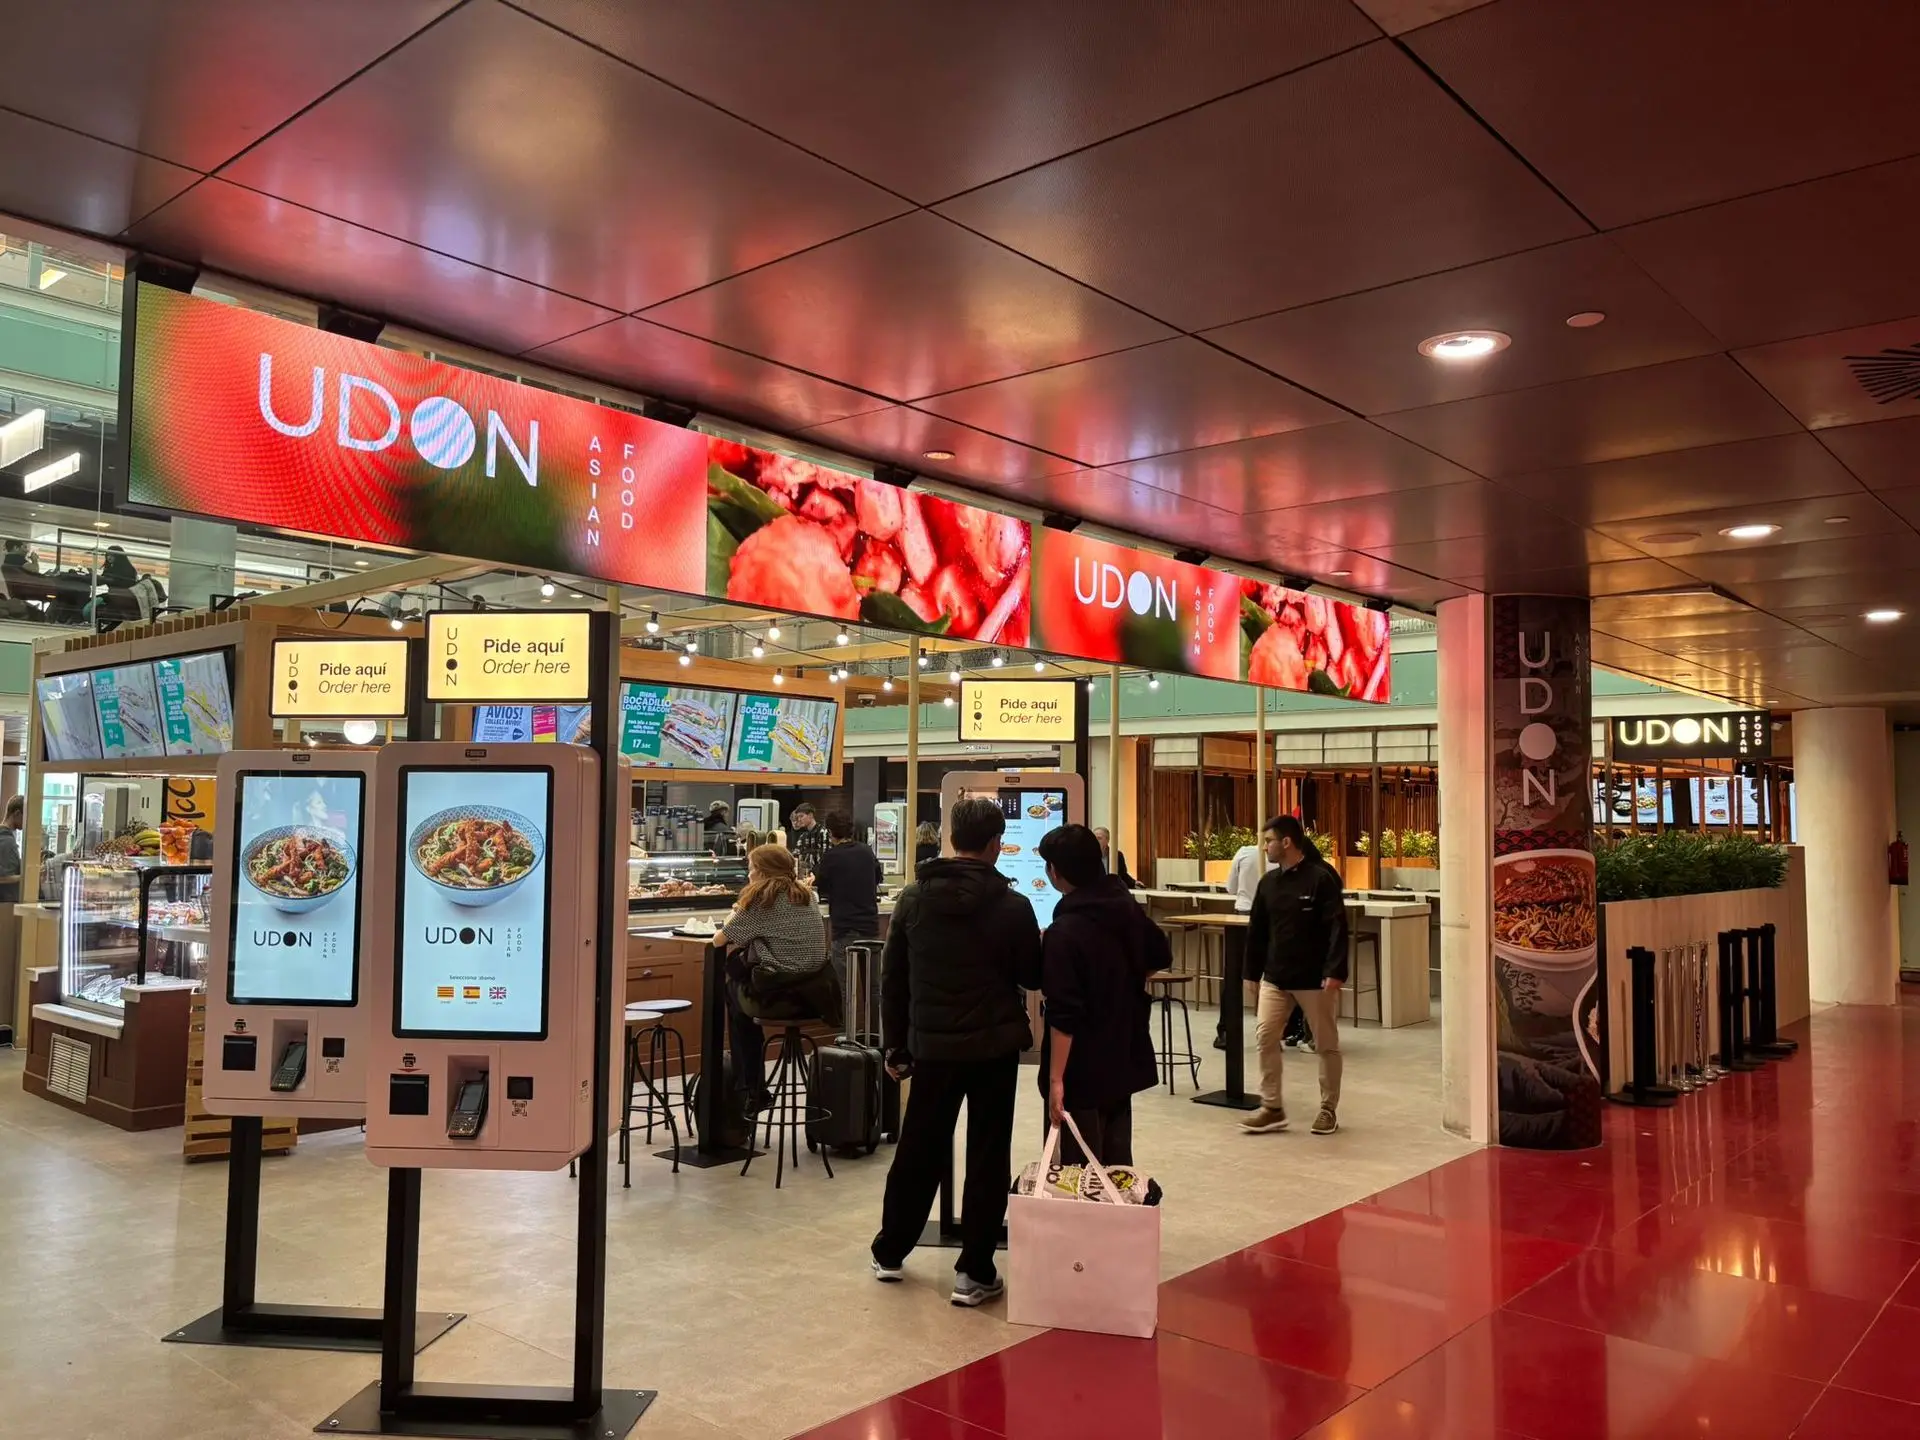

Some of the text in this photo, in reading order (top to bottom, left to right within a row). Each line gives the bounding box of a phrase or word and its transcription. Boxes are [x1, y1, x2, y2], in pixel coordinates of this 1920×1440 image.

[259, 352, 539, 487] UDON
[586, 435, 602, 547] ASIAN
[620, 443, 635, 530] FOOD
[1074, 556, 1177, 622] UDON
[1193, 585, 1201, 656] ASIAN
[1207, 588, 1215, 643] FOOD
[446, 627, 458, 687] UDON
[483, 638, 565, 656] Pide aquí
[287, 653, 299, 704] UDON
[319, 662, 388, 678] Pide aquí
[483, 658, 570, 674] Order here
[318, 680, 391, 694] Order here
[623, 695, 671, 707] BOCADILLO
[486, 705, 524, 720] AVIOS!
[622, 703, 641, 712] LOMO
[740, 705, 782, 717] BOCADILLO
[973, 690, 983, 731] UDON
[999, 712, 1062, 724] Order here
[1000, 698, 1058, 711] Pide aquí
[1518, 631, 1557, 806] UDON
[1619, 716, 1730, 746] UDON
[1739, 715, 1748, 754] ASIAN
[1754, 715, 1762, 746] FOOD
[253, 930, 313, 947] UDON
[425, 926, 494, 945] UDON
